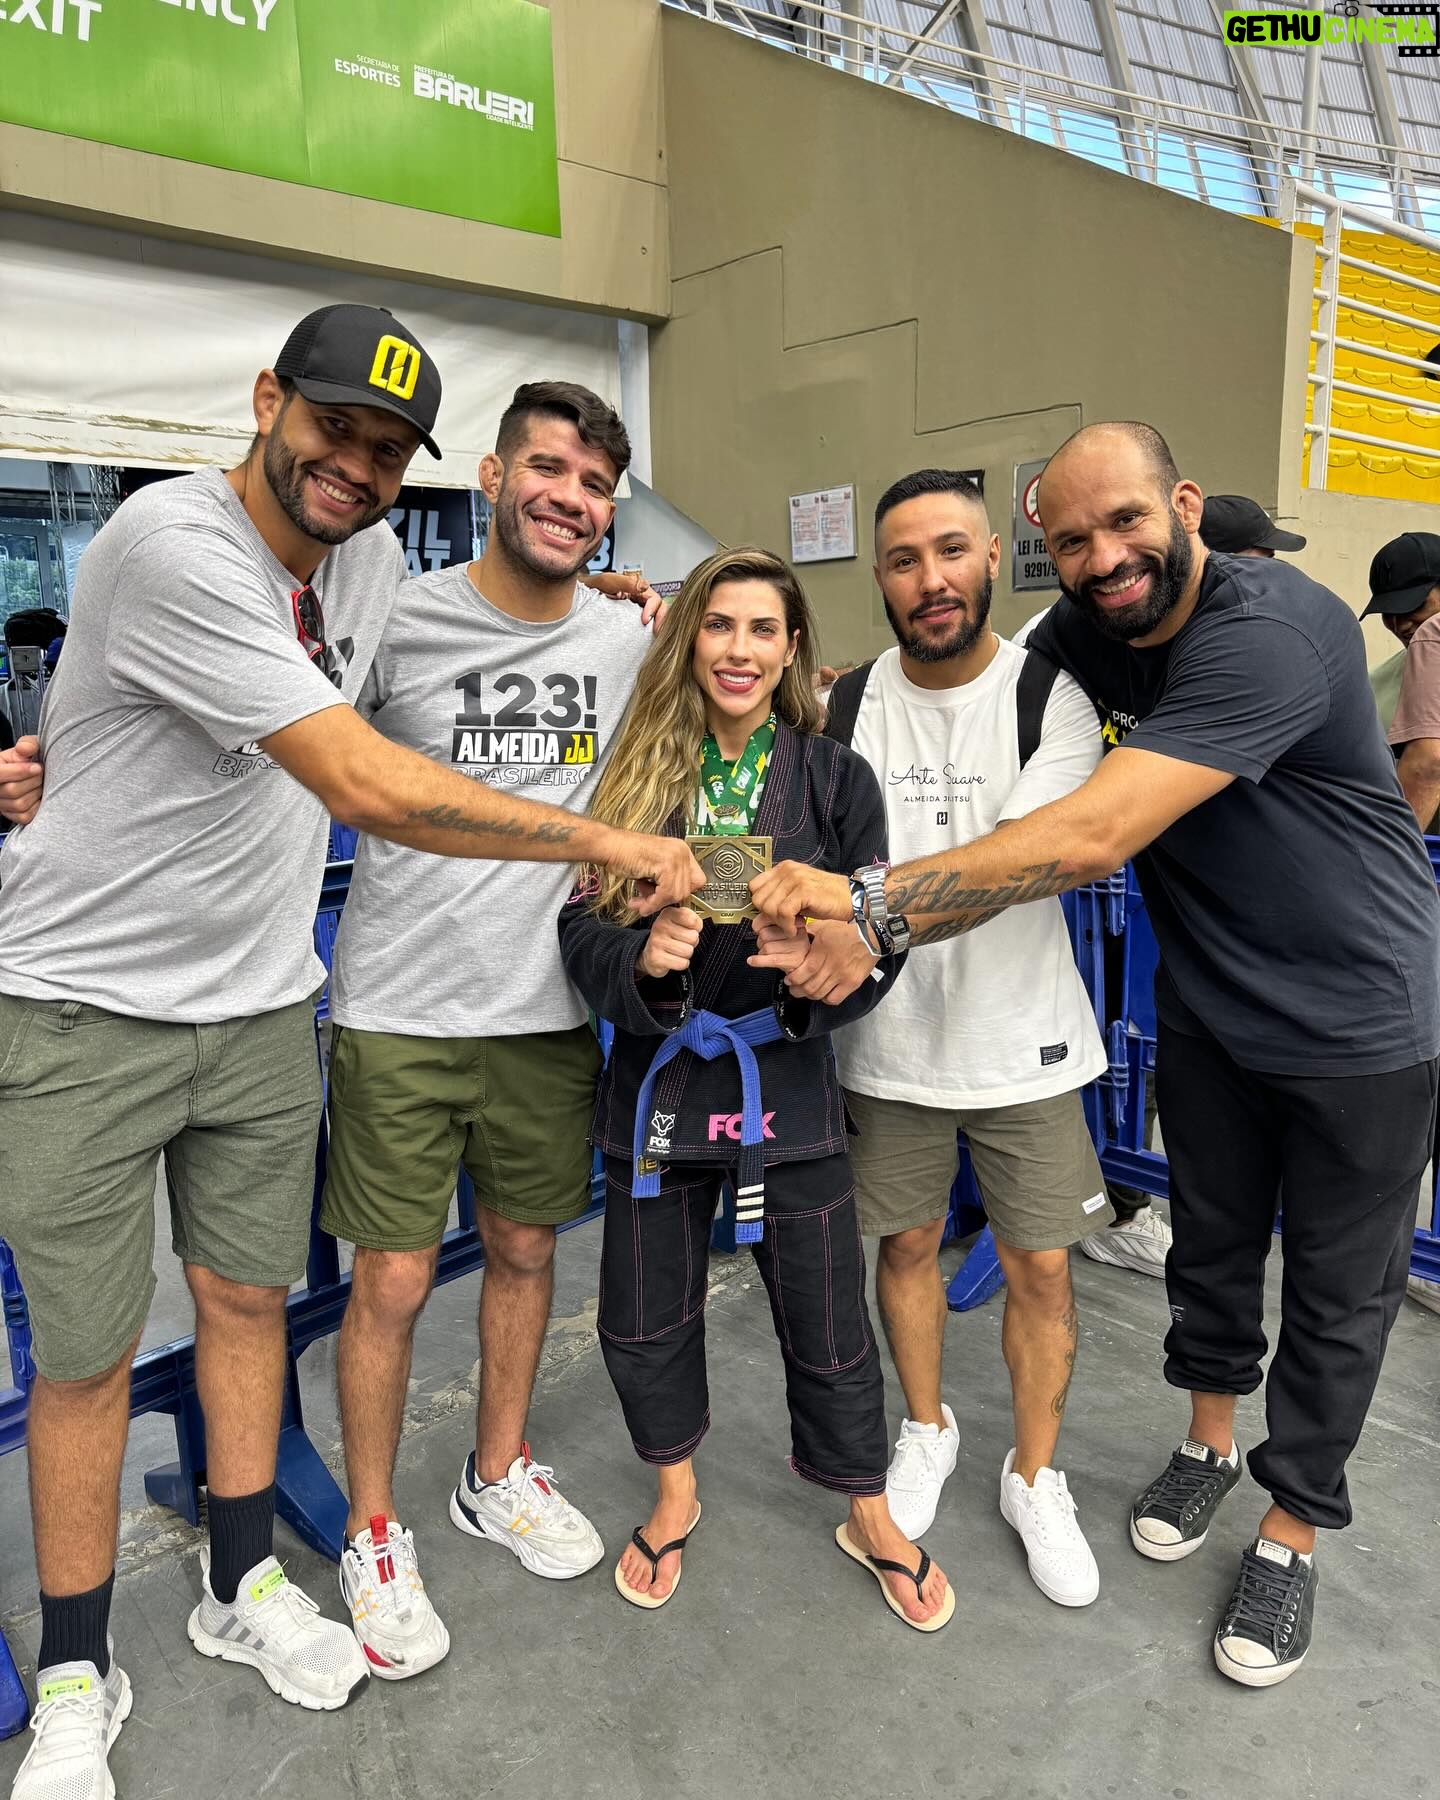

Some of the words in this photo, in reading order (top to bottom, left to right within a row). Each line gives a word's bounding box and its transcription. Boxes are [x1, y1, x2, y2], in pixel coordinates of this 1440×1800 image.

[0, 0, 102, 42] XIT
[334, 58, 401, 88] ESPORTES
[391, 64, 400, 73] DE
[413, 72, 534, 126] BARUERI
[1018, 540, 1030, 556] LEI
[455, 672, 597, 728] 123!
[457, 731, 560, 764] ALMEIDA
[564, 733, 594, 764] JJ
[888, 763, 938, 786] Arte
[942, 762, 987, 785] Suave
[903, 795, 941, 803] ALMEIDA
[650, 1135, 671, 1148] FOX
